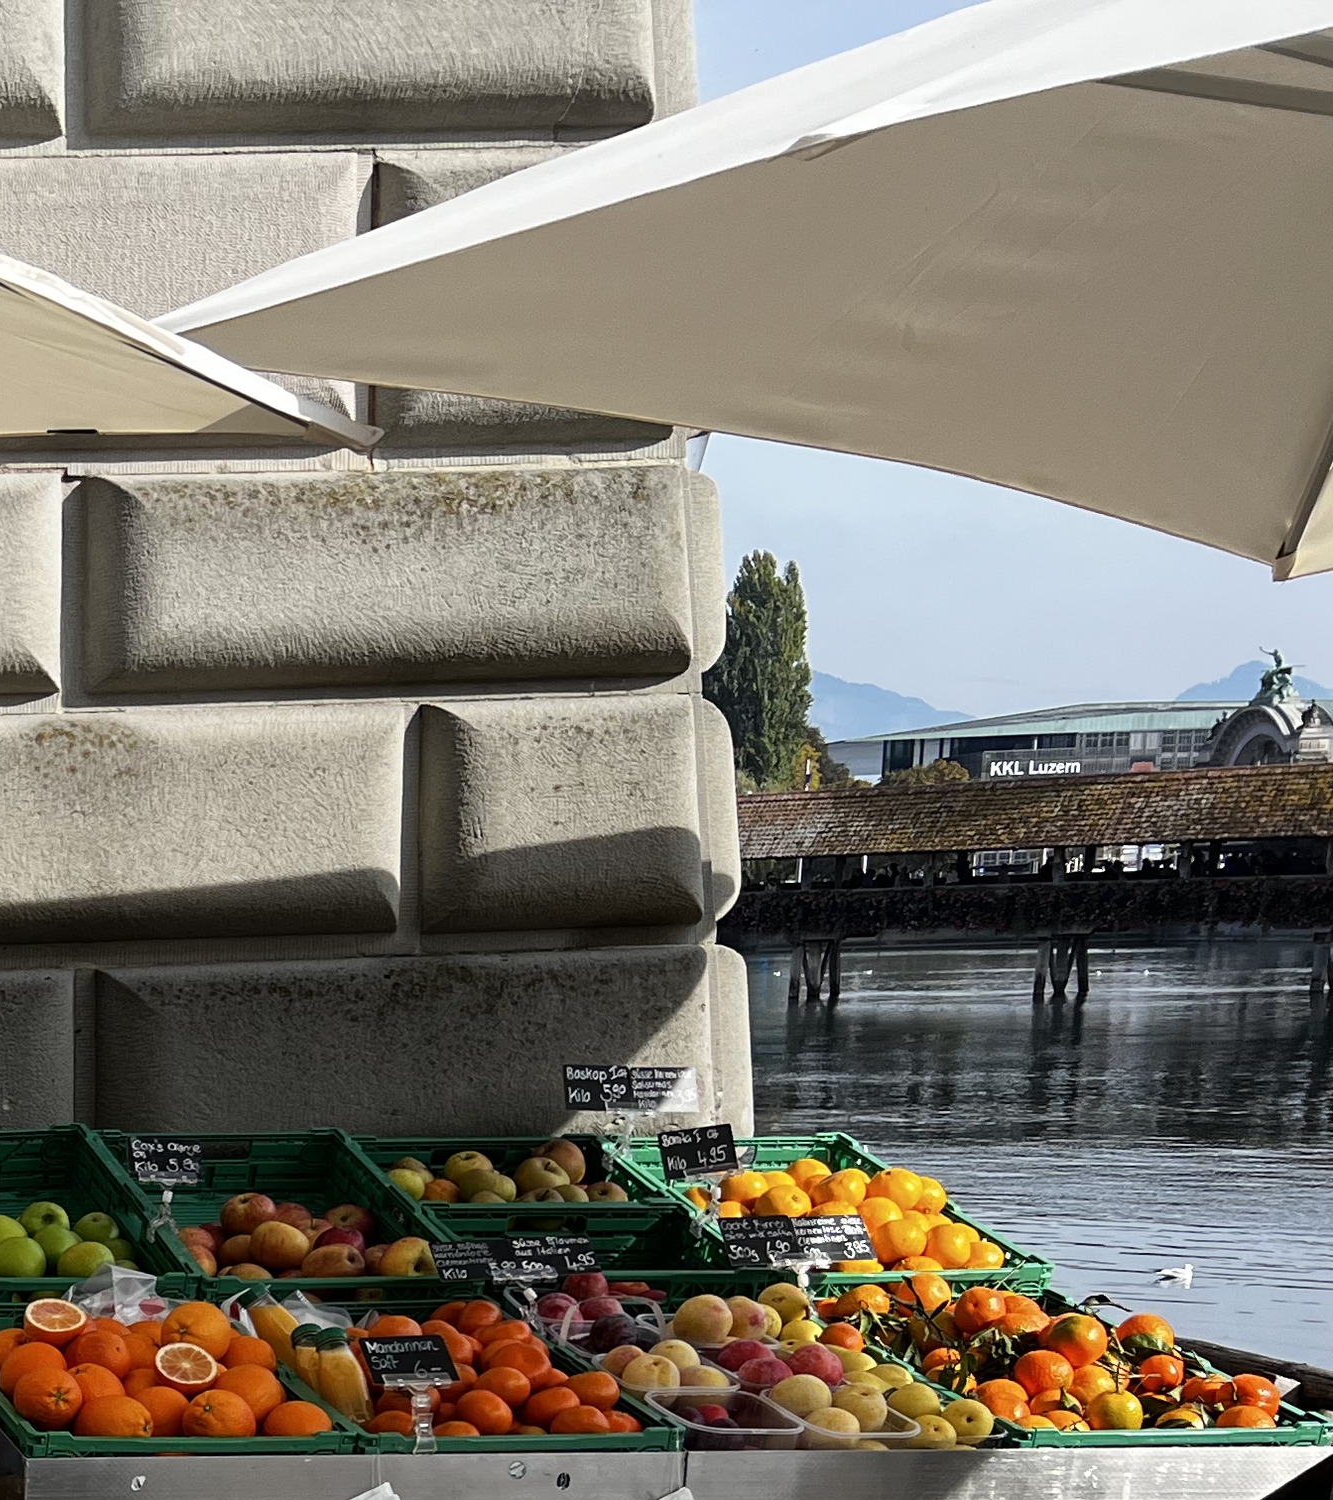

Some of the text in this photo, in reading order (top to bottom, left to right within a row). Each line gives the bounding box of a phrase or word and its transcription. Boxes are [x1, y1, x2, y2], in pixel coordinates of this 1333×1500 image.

[990, 760, 1081, 776] KKL Luzern
[568, 1084, 627, 1104] Kilo 5.90
[134, 1161, 159, 1173] Kilo
[666, 1156, 687, 1172] Kilo
[564, 1252, 596, 1271] 4.95
[728, 1244, 760, 1263] 500g
[442, 1269, 468, 1280] Kilo
